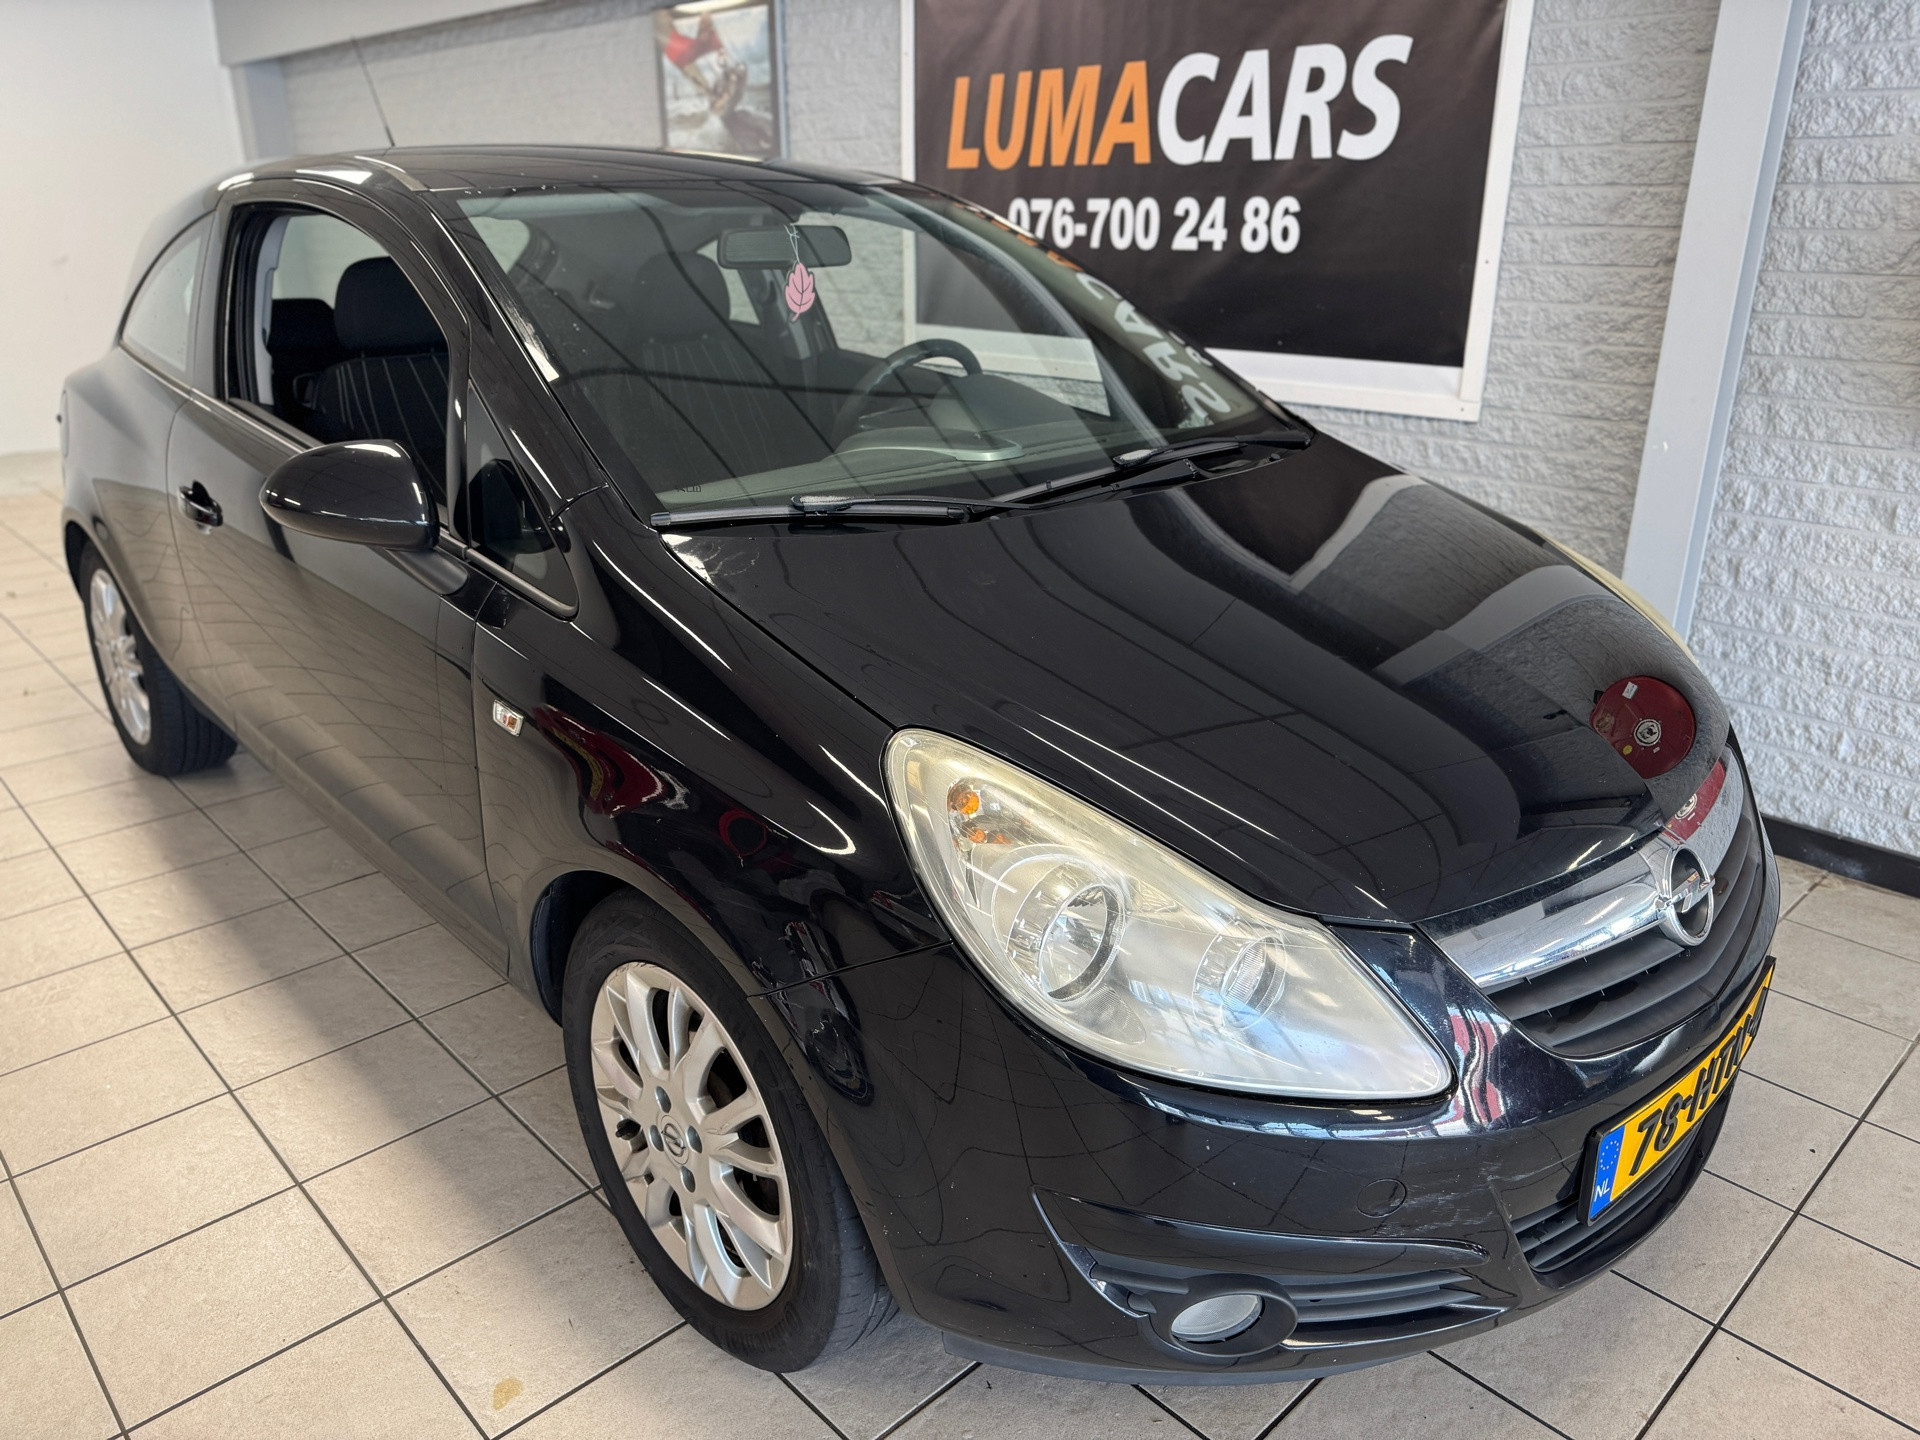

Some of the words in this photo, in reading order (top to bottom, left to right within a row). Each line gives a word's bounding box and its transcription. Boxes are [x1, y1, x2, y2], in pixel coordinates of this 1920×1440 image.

[946, 33, 1414, 171] LUMACARS
[1008, 197, 1161, 251] 076-700
[1170, 196, 1229, 251] 24
[1240, 195, 1302, 254] 86
[1594, 1178, 1611, 1202] NL
